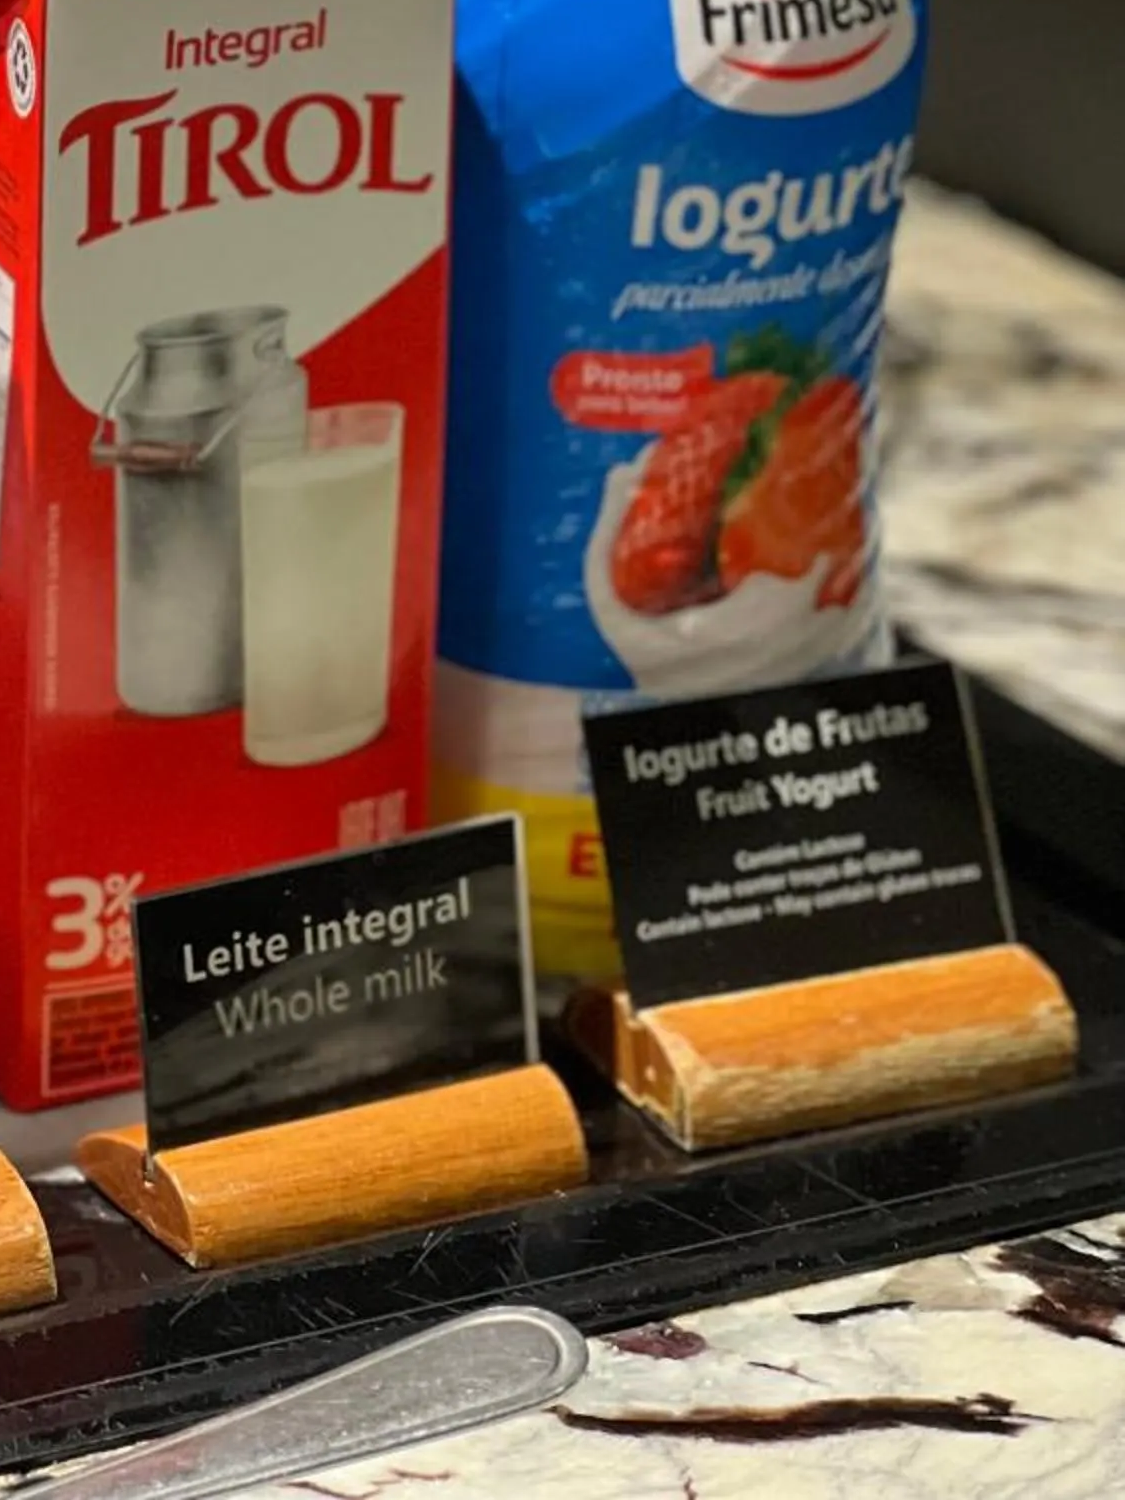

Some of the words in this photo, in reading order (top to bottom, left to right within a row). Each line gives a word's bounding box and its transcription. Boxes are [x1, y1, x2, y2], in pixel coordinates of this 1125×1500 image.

[165, 8, 327, 71] Integral
[58, 89, 433, 247] TIROL
[623, 731, 759, 786] Iogurte
[764, 717, 813, 757] de
[816, 702, 929, 748] Frutas
[696, 780, 771, 821] Fruit
[770, 761, 879, 809] Yogurt
[183, 931, 289, 984] Leite
[303, 877, 471, 955] integral
[215, 976, 351, 1039] Whole
[364, 948, 449, 1001] milk
